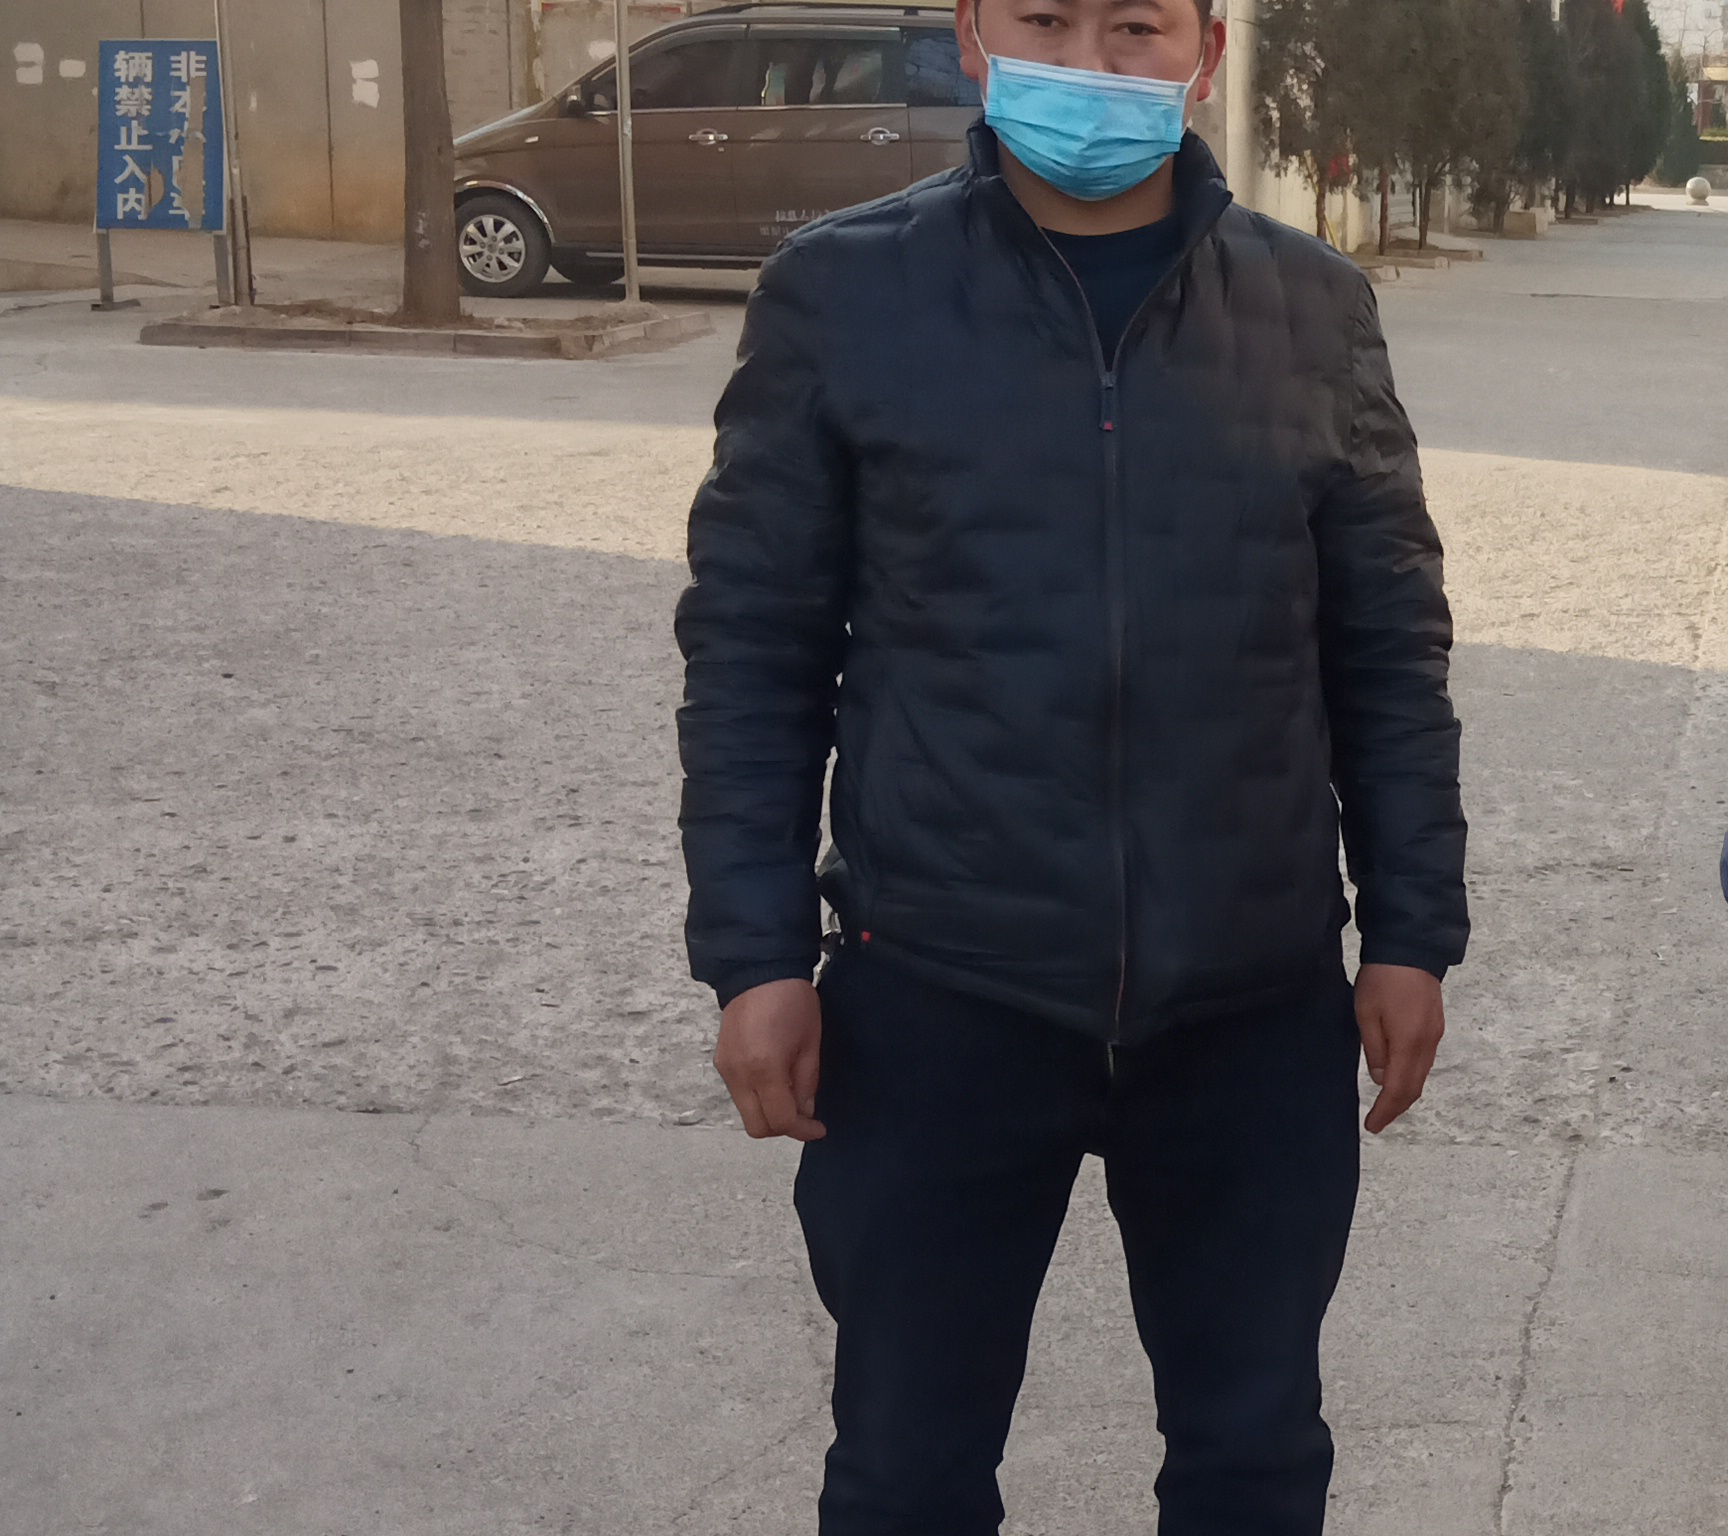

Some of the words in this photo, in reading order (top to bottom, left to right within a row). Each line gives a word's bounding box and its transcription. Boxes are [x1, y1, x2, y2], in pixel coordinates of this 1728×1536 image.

[113, 50, 153, 221] 辆禁止入内
